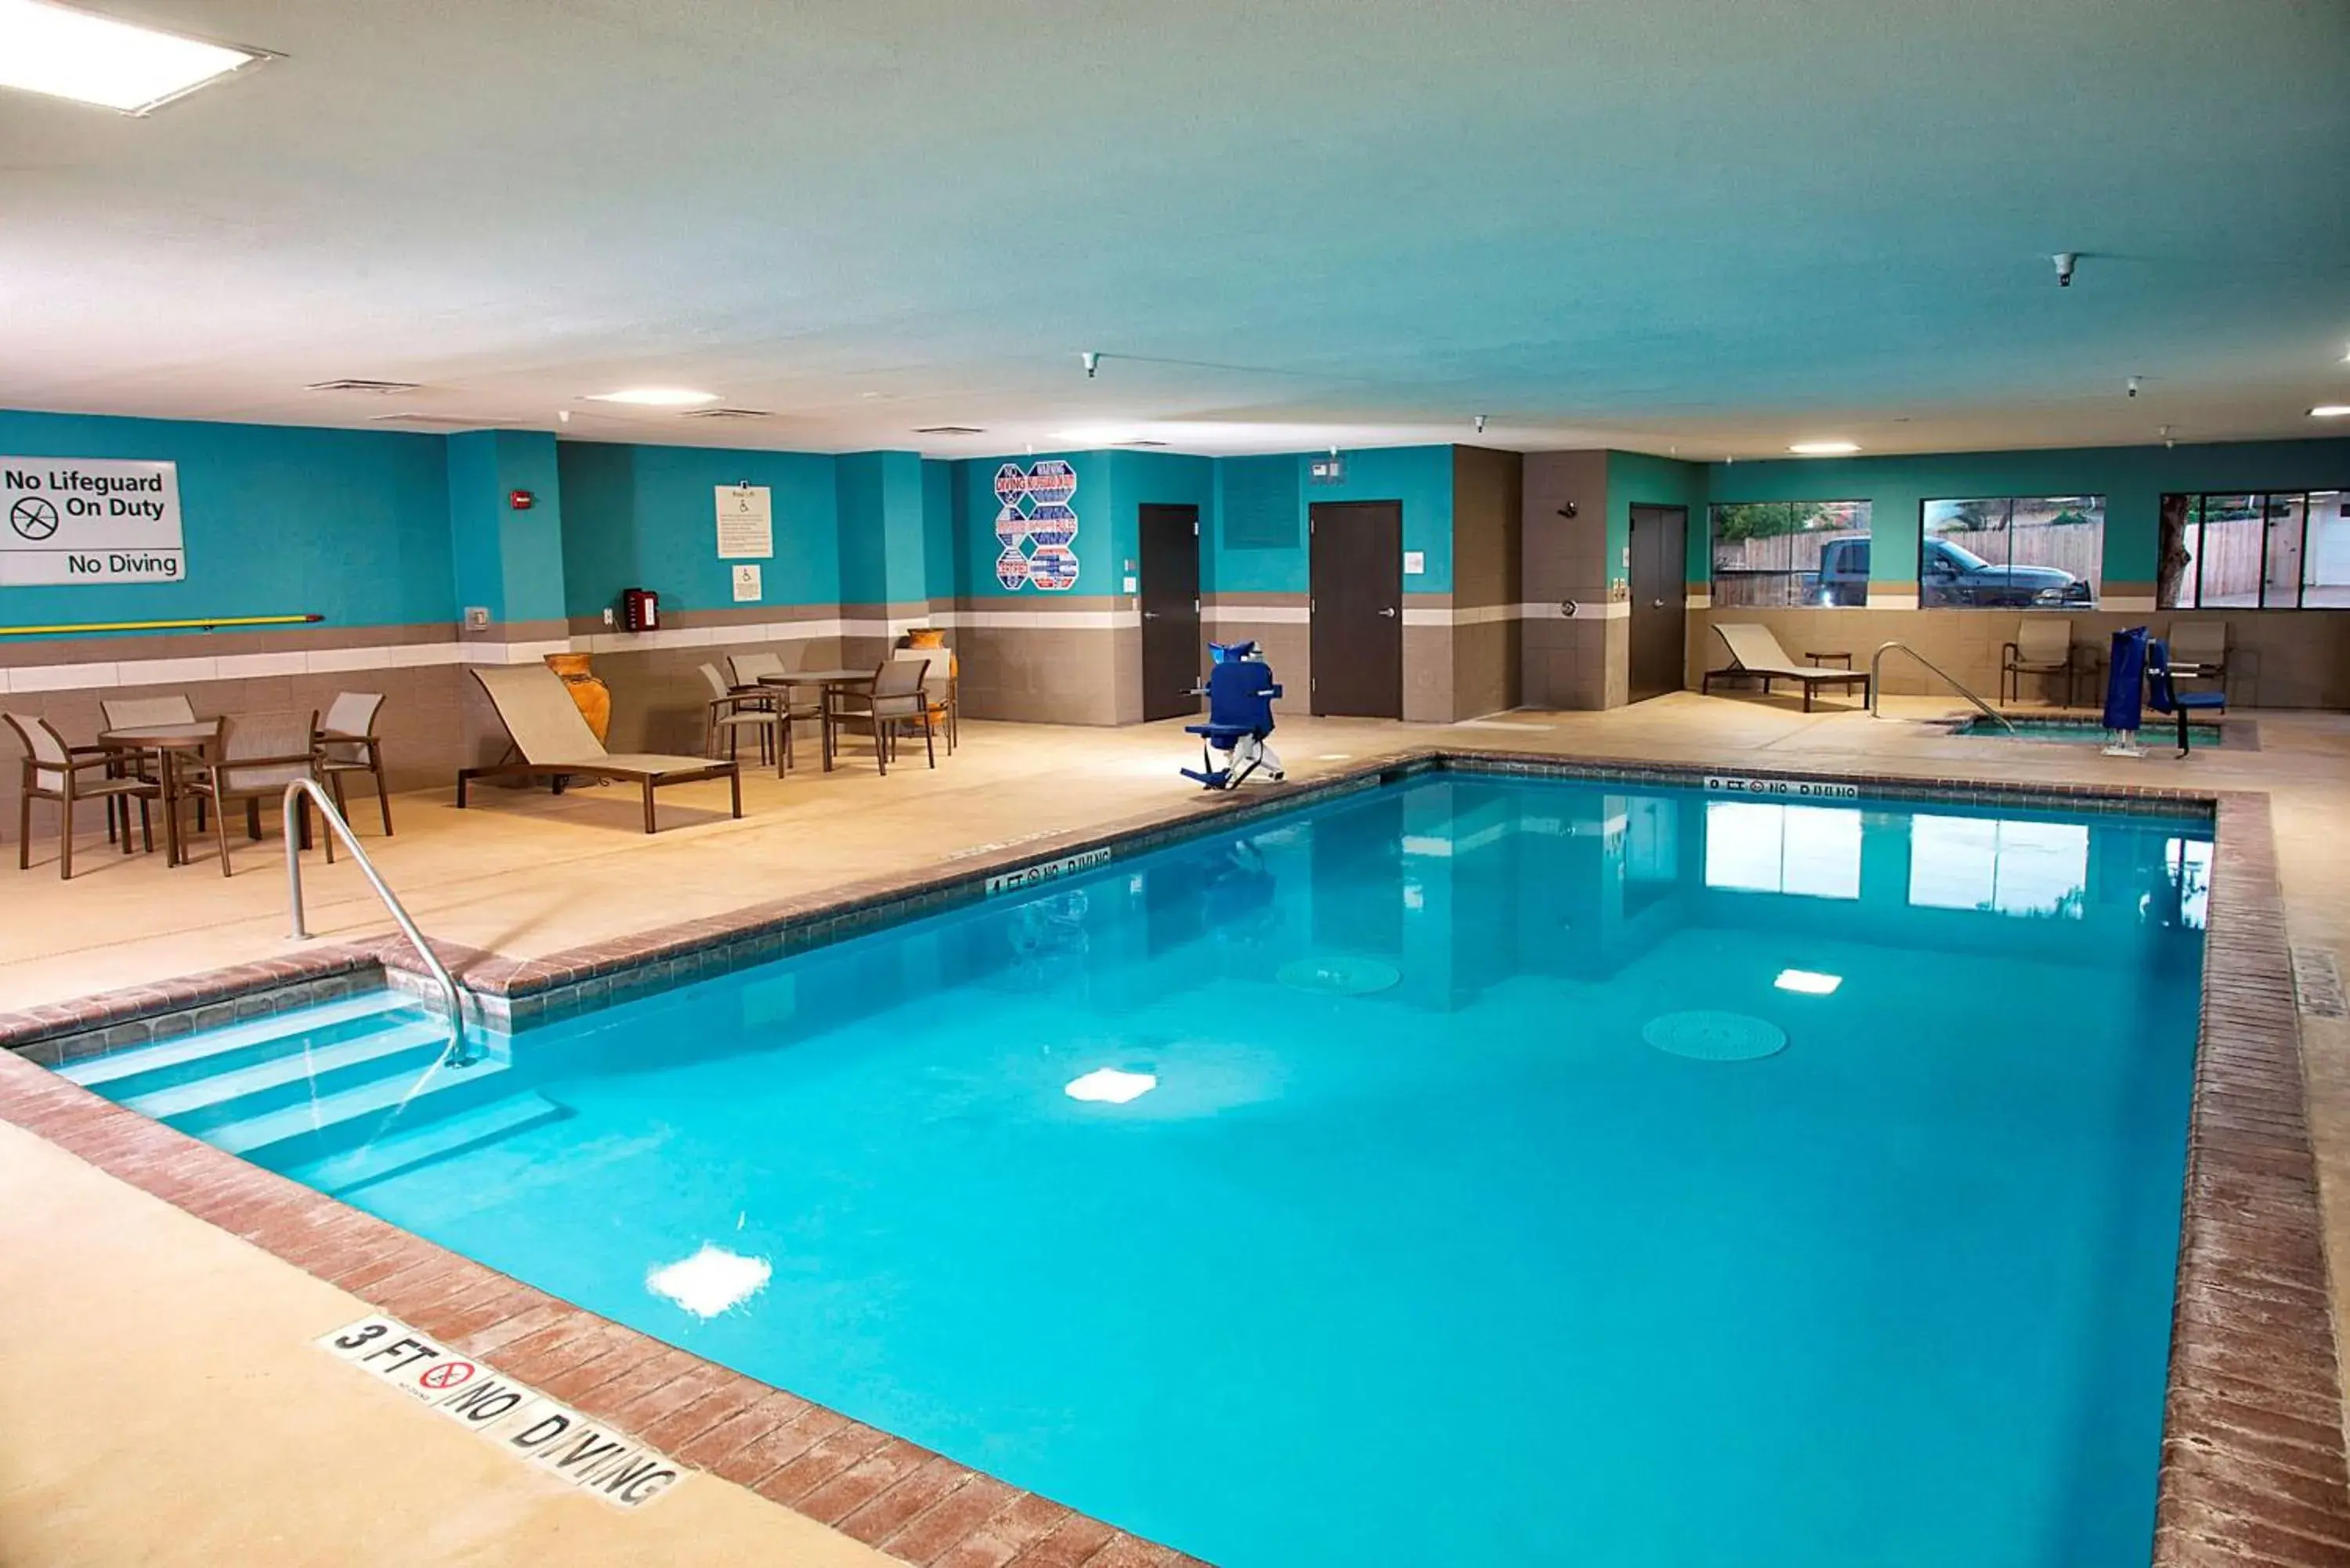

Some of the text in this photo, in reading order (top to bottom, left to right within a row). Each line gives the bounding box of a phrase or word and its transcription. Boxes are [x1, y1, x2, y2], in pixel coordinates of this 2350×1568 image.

[5, 470, 162, 496] No Lifeguard
[66, 497, 164, 521] On Duty
[69, 554, 177, 576] No Diving
[334, 1324, 677, 1505] 3 FT NO DIVING
